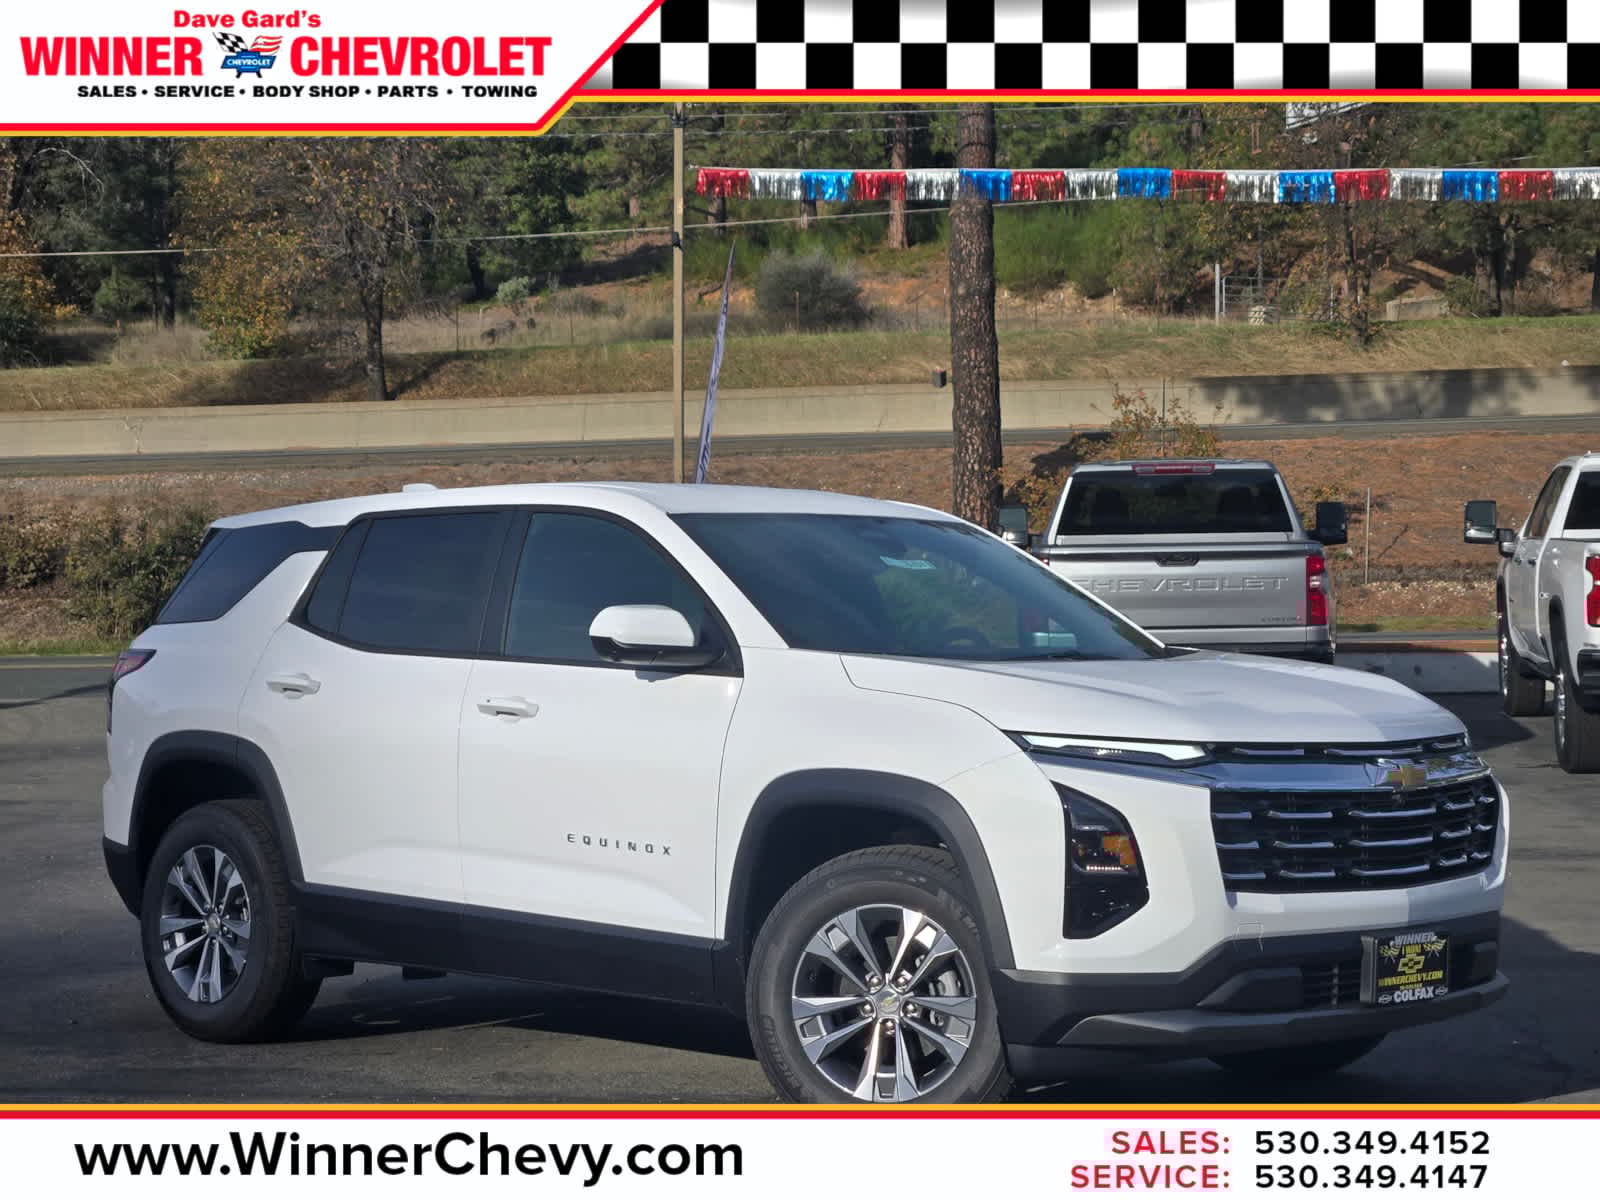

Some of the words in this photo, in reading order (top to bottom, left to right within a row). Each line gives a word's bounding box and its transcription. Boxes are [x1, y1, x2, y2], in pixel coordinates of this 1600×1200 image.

[566, 833, 671, 856] EQUINOX
[1394, 932, 1437, 945] WINNER
[1393, 986, 1435, 1003] COLFAX
